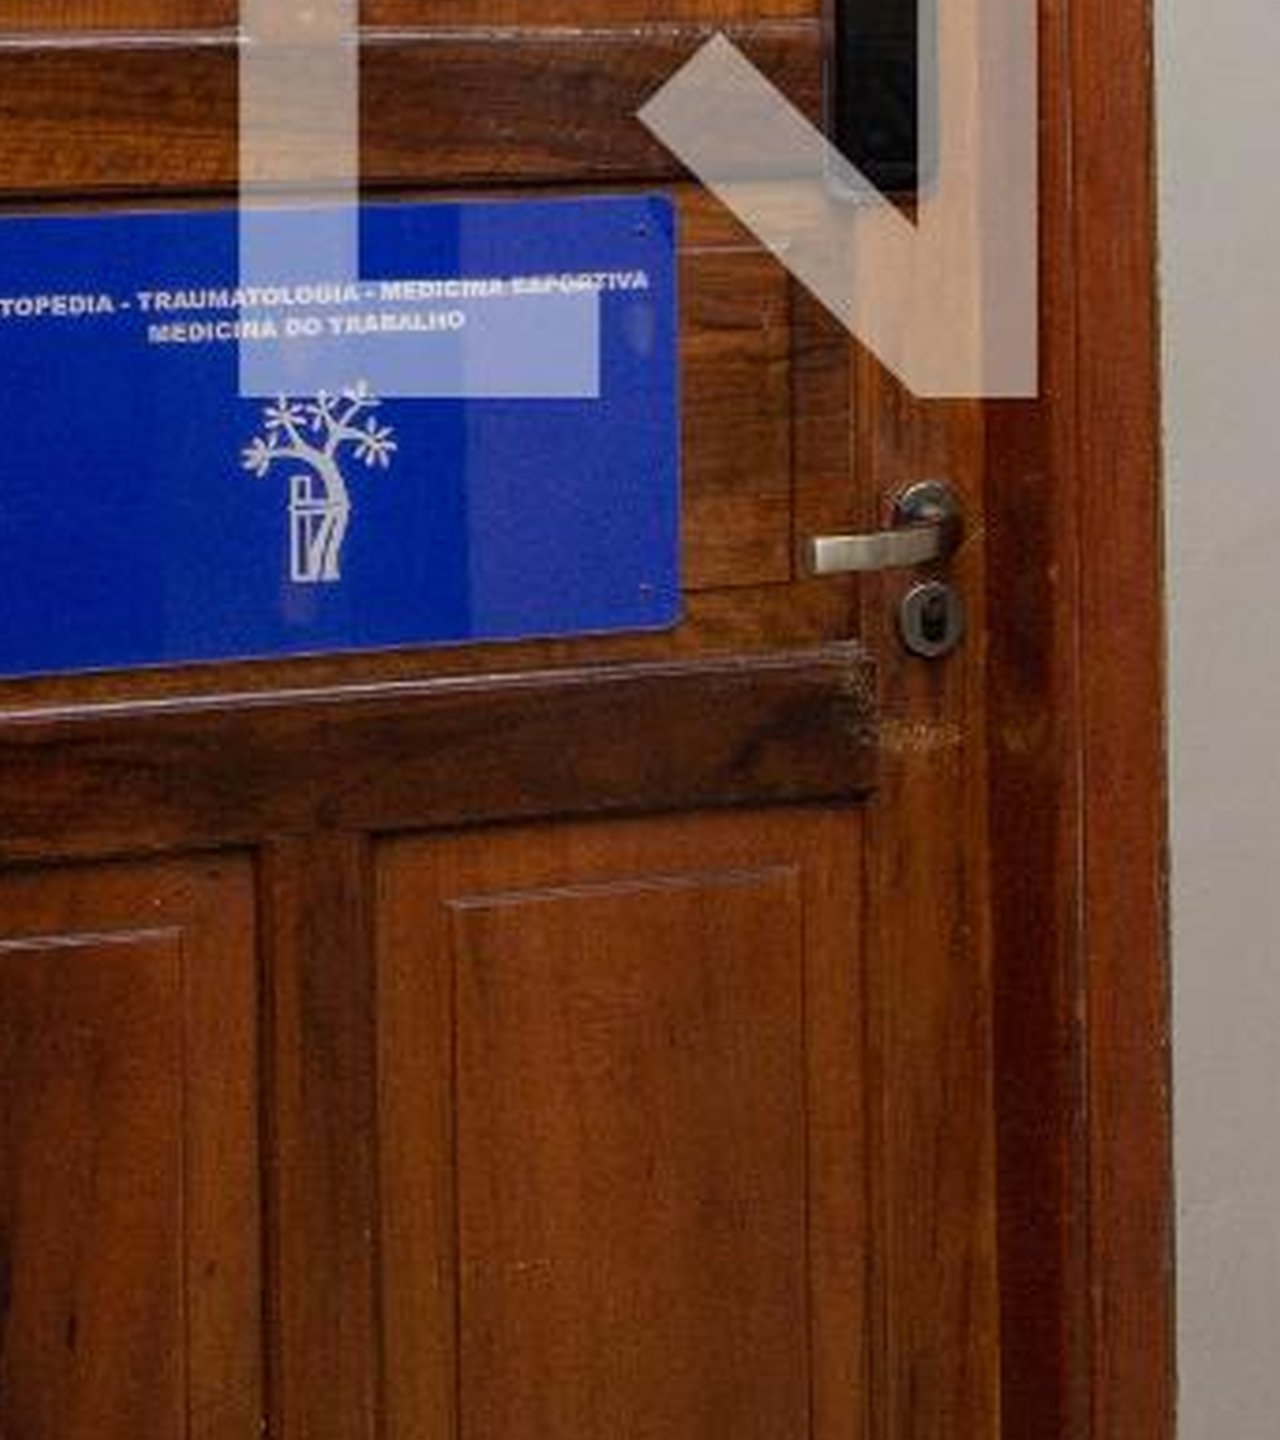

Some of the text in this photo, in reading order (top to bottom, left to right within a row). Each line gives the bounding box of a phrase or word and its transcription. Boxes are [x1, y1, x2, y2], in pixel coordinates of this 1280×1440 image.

[136, 283, 360, 312] TRAUMATOLOGIA
[380, 277, 504, 302] MEDICINA
[148, 321, 278, 345] MEDICINA
[286, 317, 322, 336] DO
